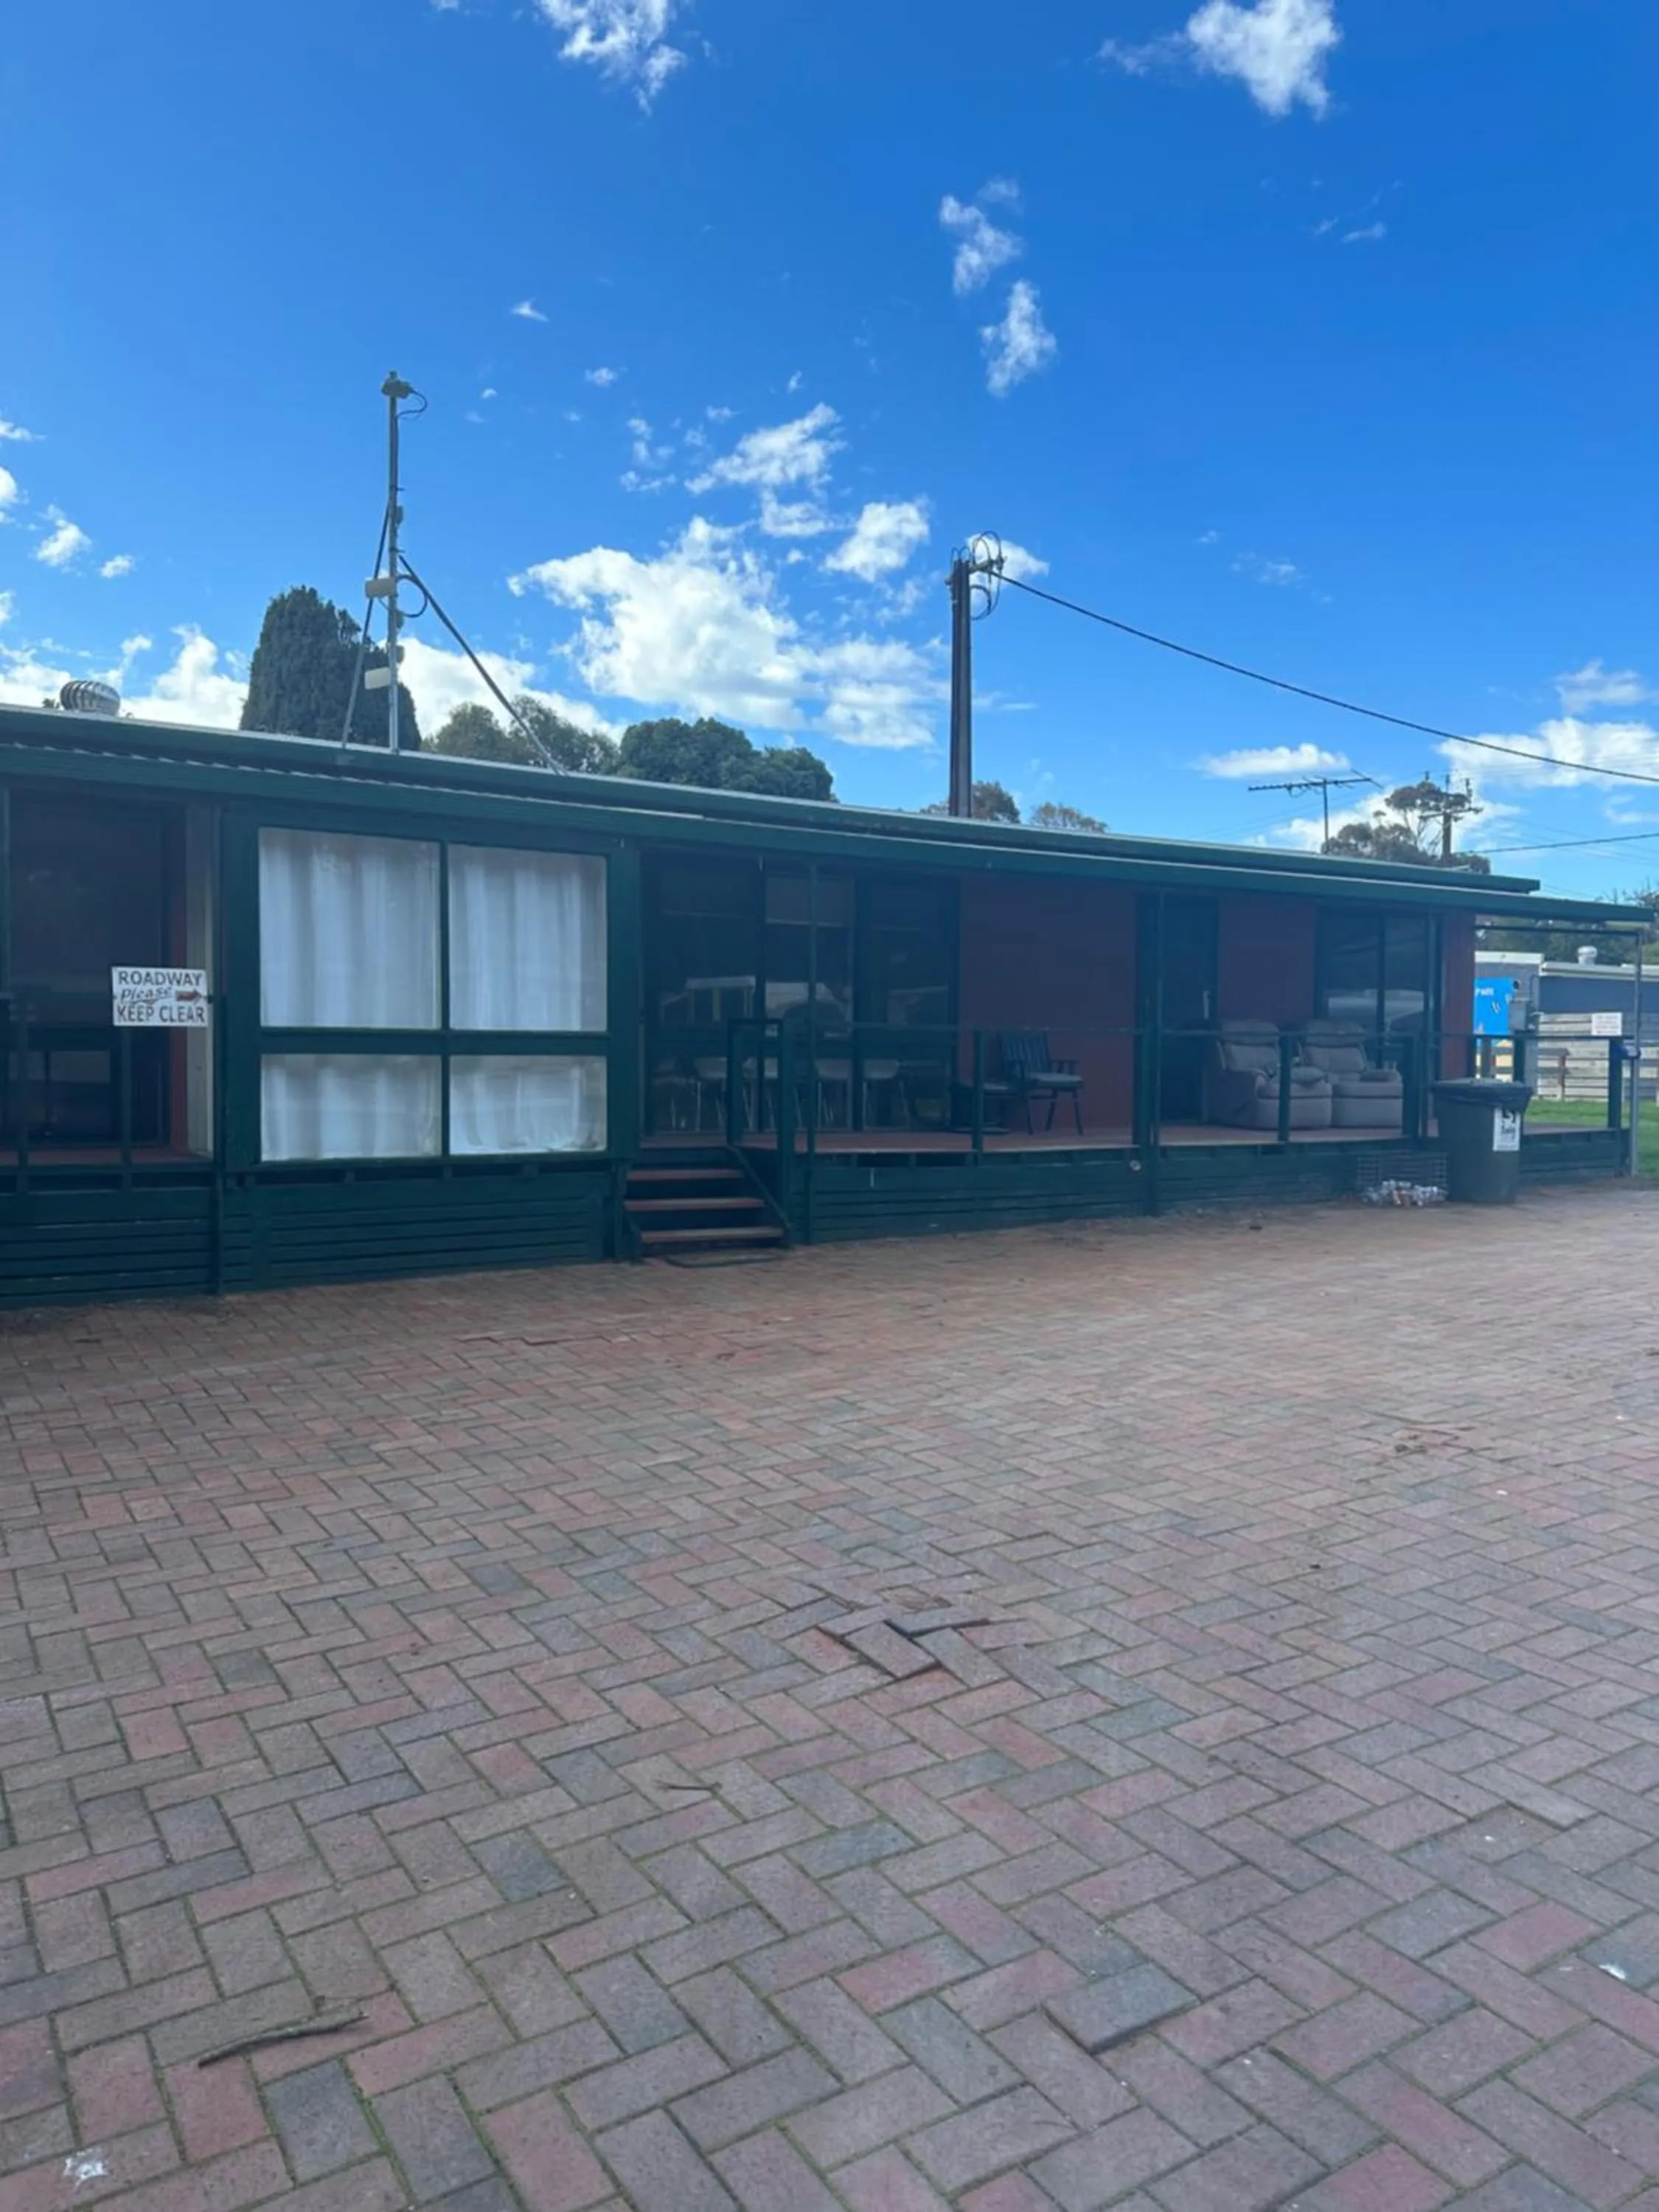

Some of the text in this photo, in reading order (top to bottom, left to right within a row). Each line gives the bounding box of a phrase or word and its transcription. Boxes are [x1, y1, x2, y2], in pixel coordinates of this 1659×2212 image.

[118, 970, 203, 986] ROADWAY
[117, 1005, 205, 1023] KEEP CLEAR
